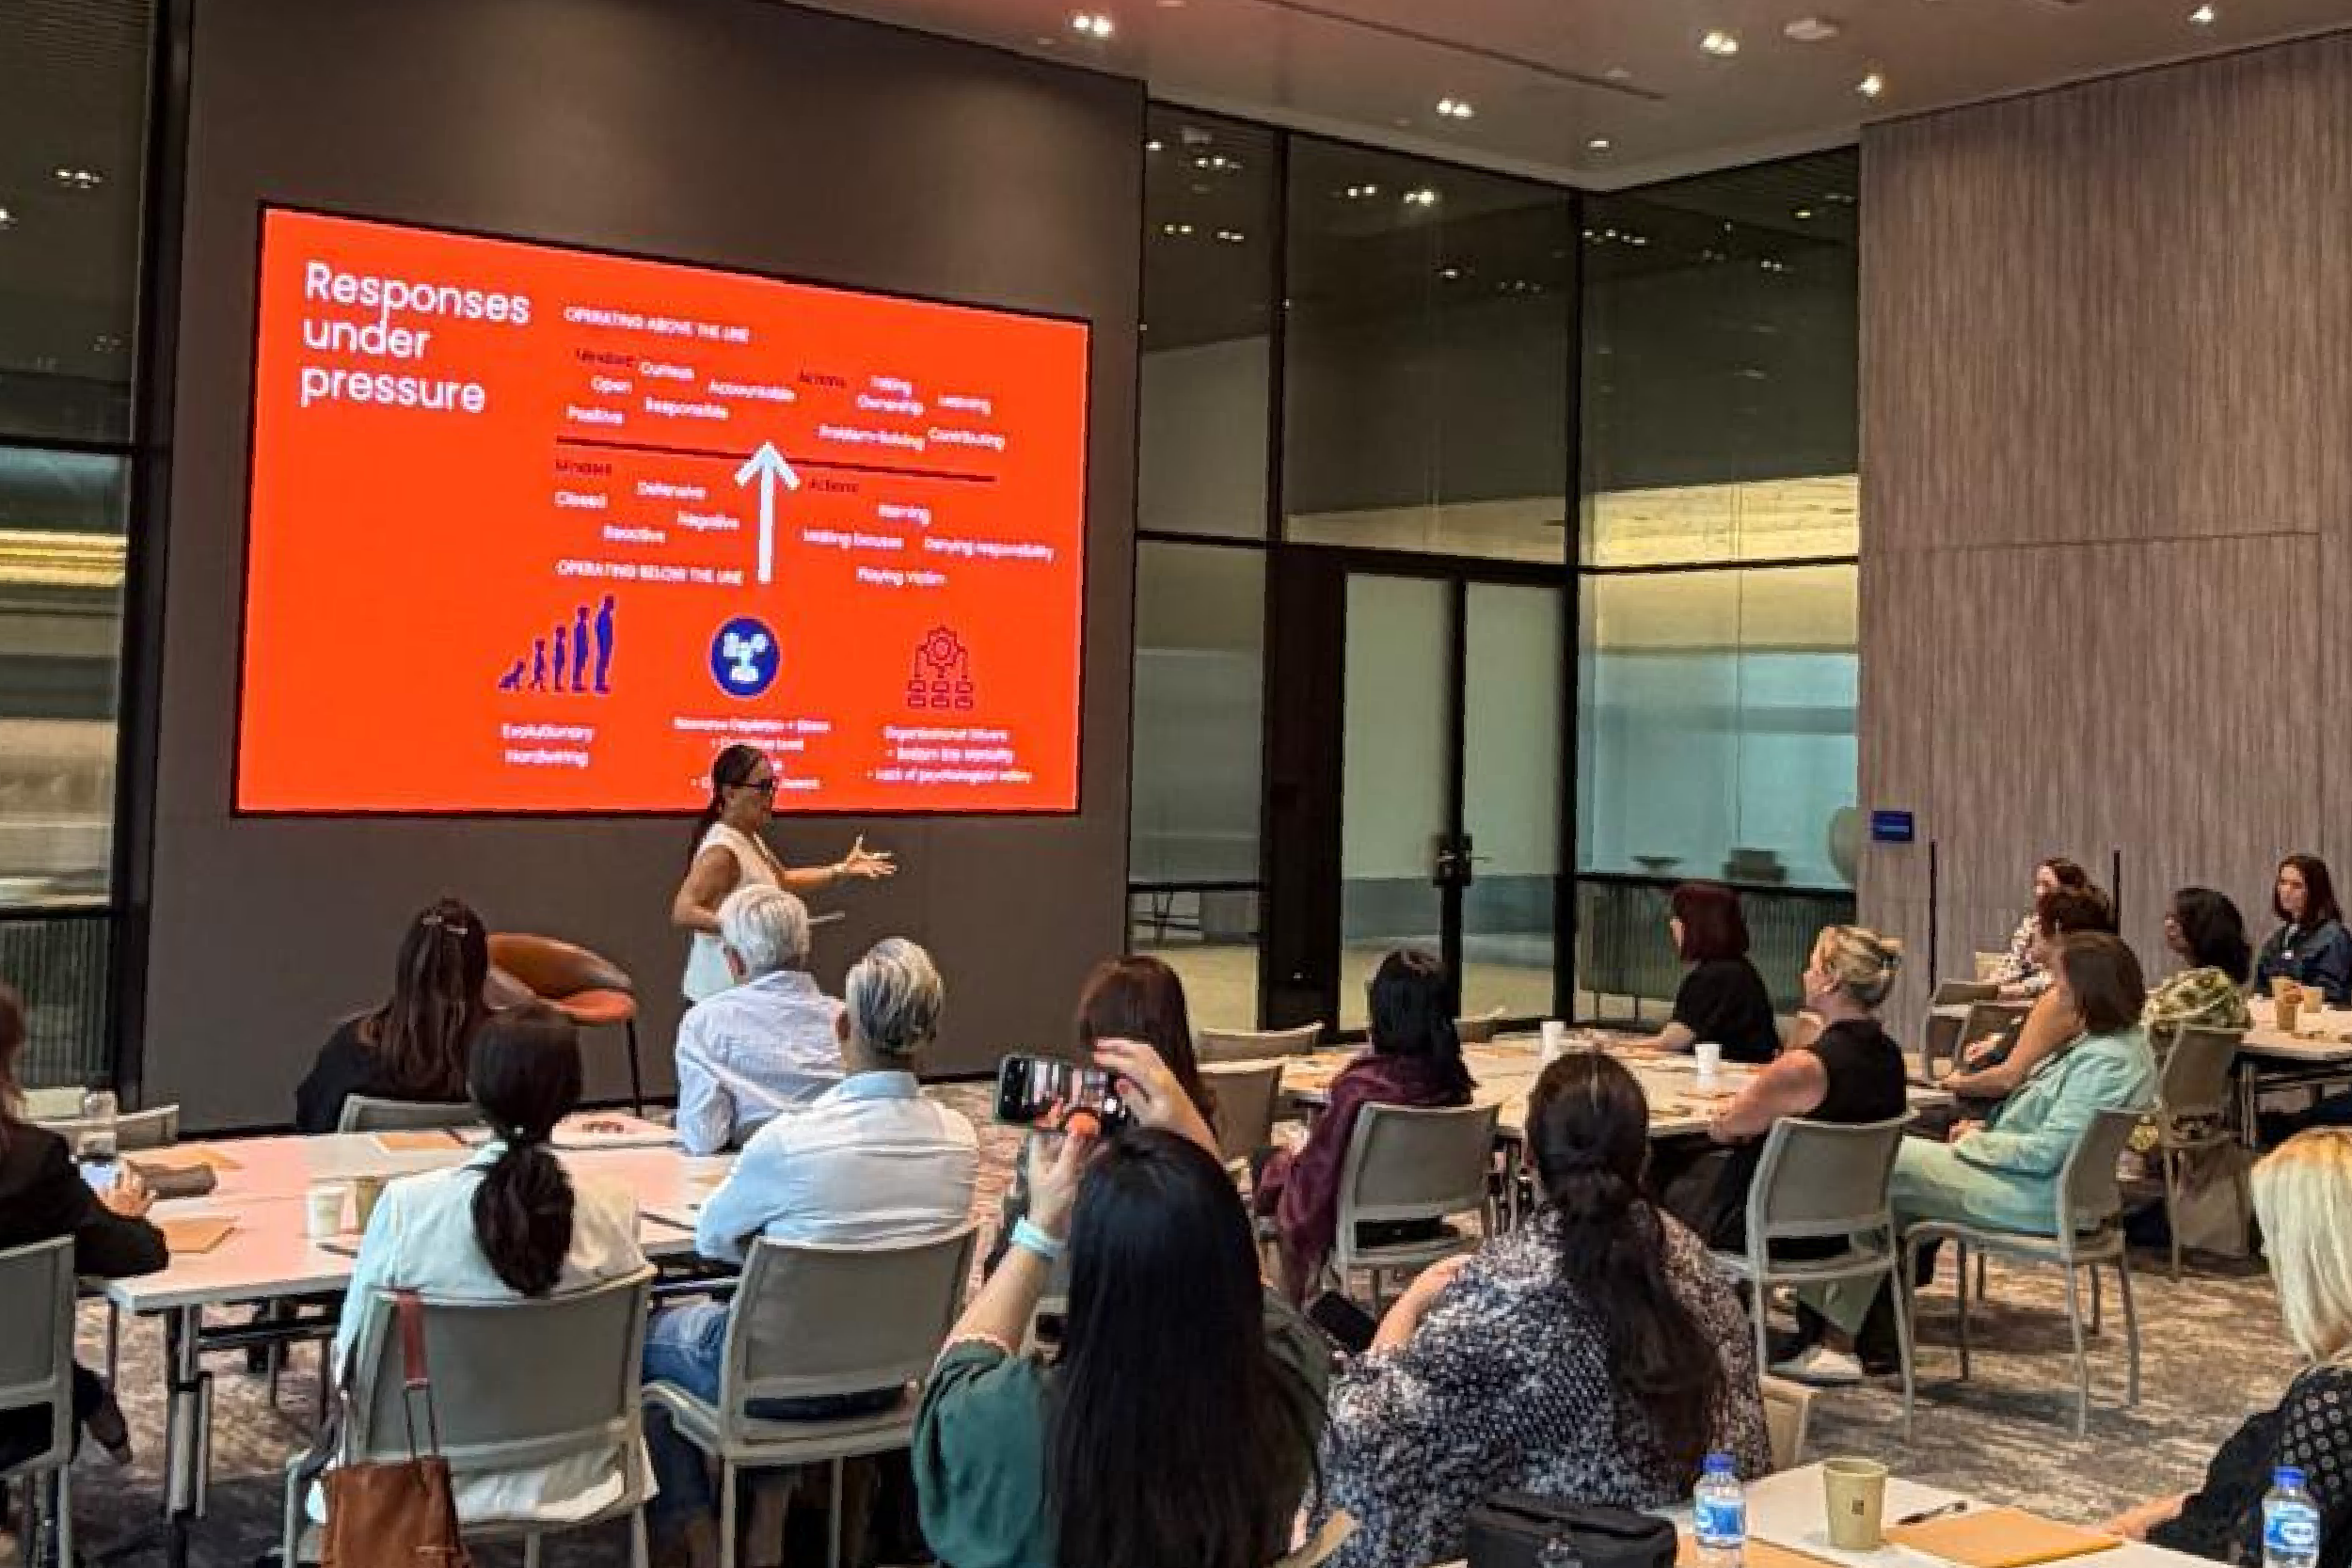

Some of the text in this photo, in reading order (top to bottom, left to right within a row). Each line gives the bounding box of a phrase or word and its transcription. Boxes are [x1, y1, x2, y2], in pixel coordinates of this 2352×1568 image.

[306, 260, 532, 325] Responses
[564, 306, 749, 344] OPERATING ABOVE THE LINE
[303, 318, 431, 359] under
[300, 366, 486, 413] pressure
[590, 374, 633, 395] Open
[567, 404, 625, 426] Positive
[644, 396, 730, 420] Responsible
[928, 426, 1006, 452] Contributing
[553, 491, 609, 510] Closed
[676, 511, 740, 532] Negative
[555, 559, 743, 587] OPERATING BELOW THE LINE
[501, 723, 595, 744] Evolutionary
